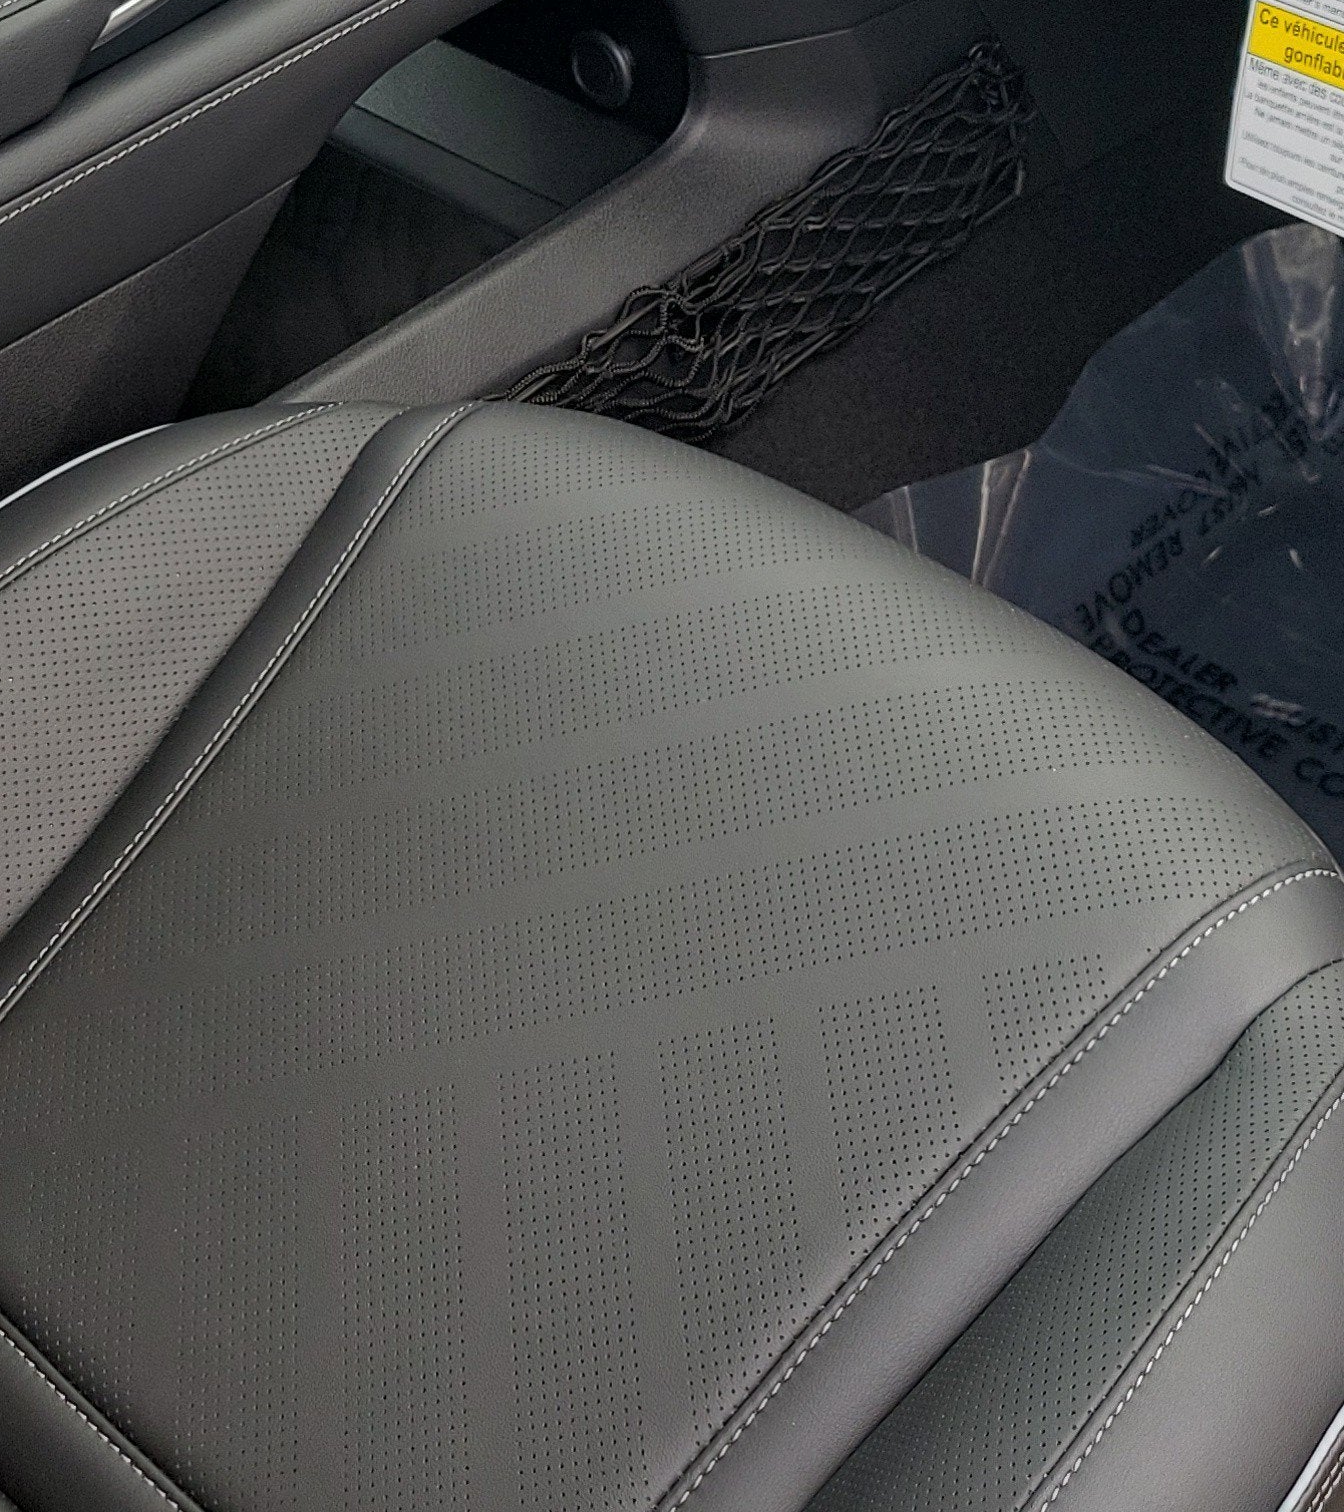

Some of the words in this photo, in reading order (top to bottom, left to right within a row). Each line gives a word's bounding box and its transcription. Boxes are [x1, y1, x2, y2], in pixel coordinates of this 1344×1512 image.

[1259, 7, 1280, 29] Ce
[1074, 529, 1186, 636] REMOVE
[1119, 608, 1240, 691] DEALER
